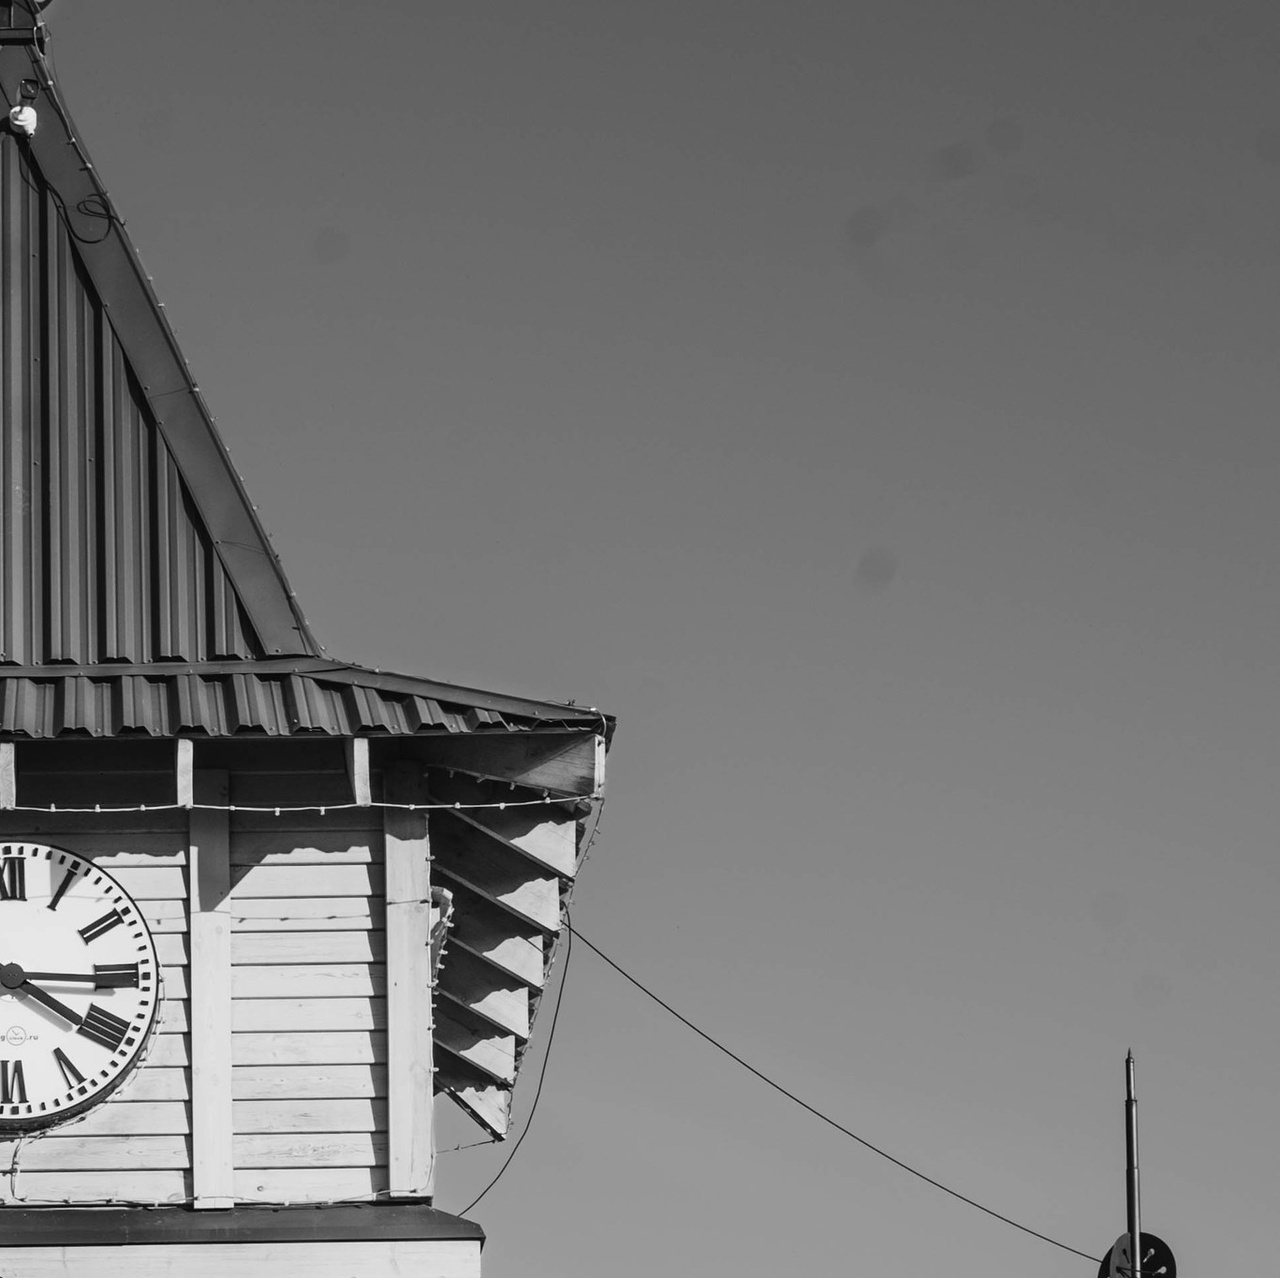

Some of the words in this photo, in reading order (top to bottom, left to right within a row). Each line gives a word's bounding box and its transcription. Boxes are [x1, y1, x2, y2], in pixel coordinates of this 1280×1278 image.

[47, 868, 77, 911] I
[77, 907, 125, 945] II
[0, 1059, 29, 1104] VI
[52, 1046, 87, 1089] V
